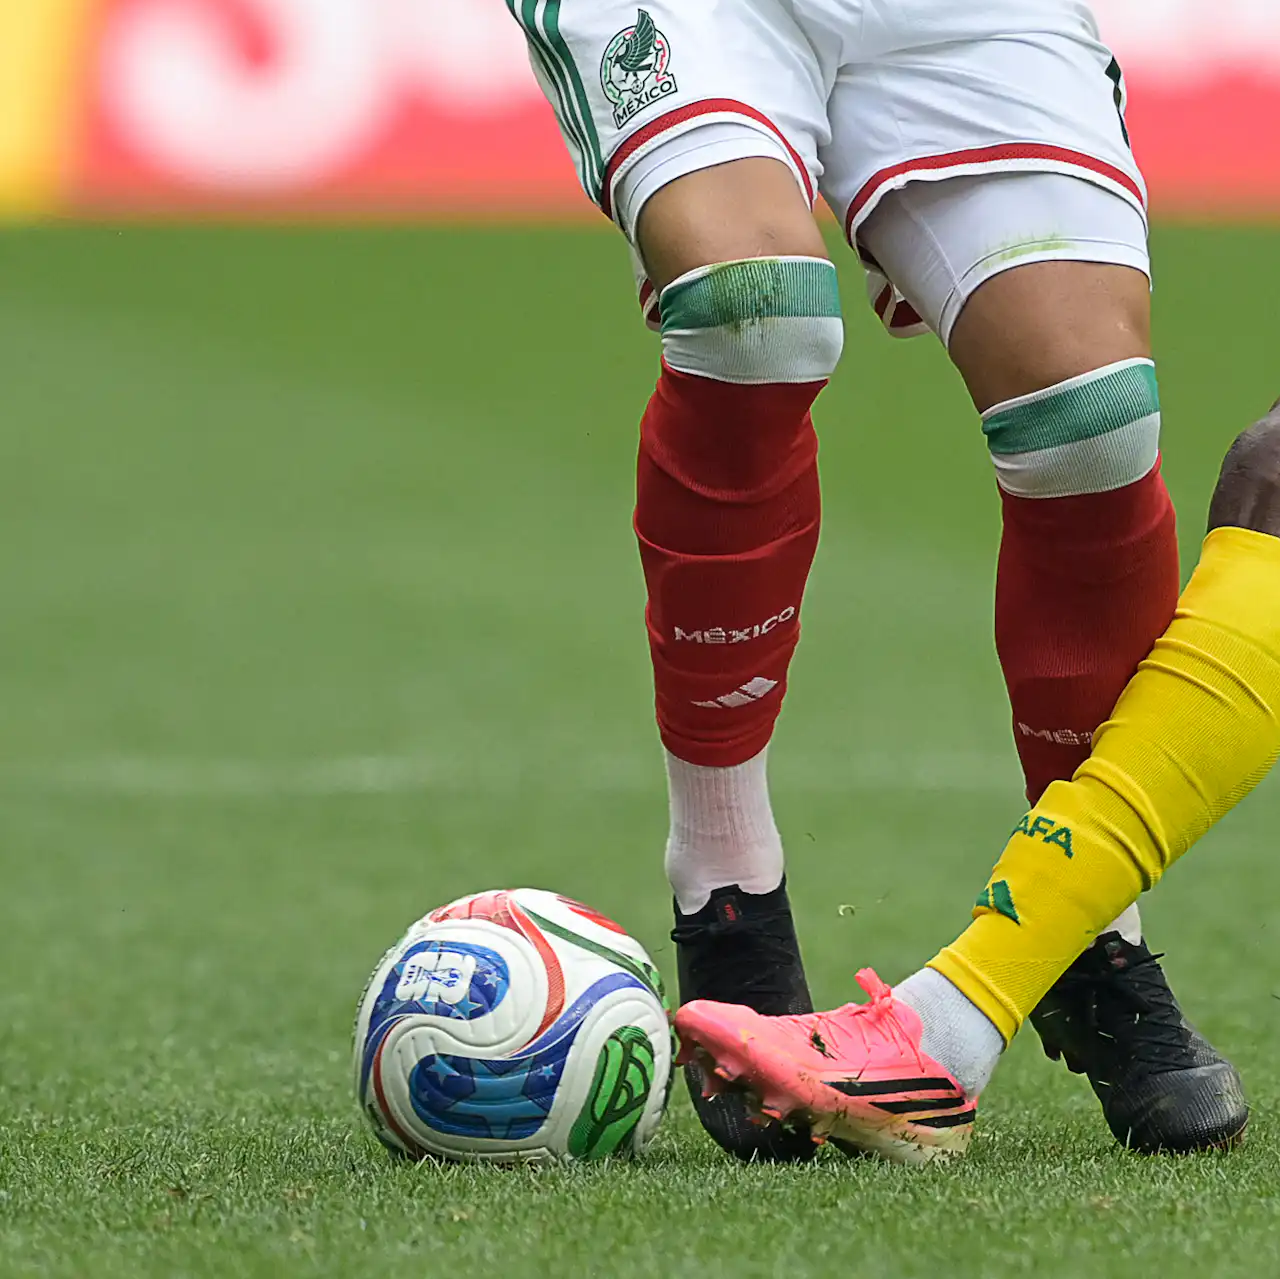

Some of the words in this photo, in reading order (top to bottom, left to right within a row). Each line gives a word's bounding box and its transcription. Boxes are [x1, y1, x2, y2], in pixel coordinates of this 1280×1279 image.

[615, 80, 673, 124] MÉXICO
[674, 606, 795, 644] MÉXICO
[1011, 815, 1074, 859] AFA
